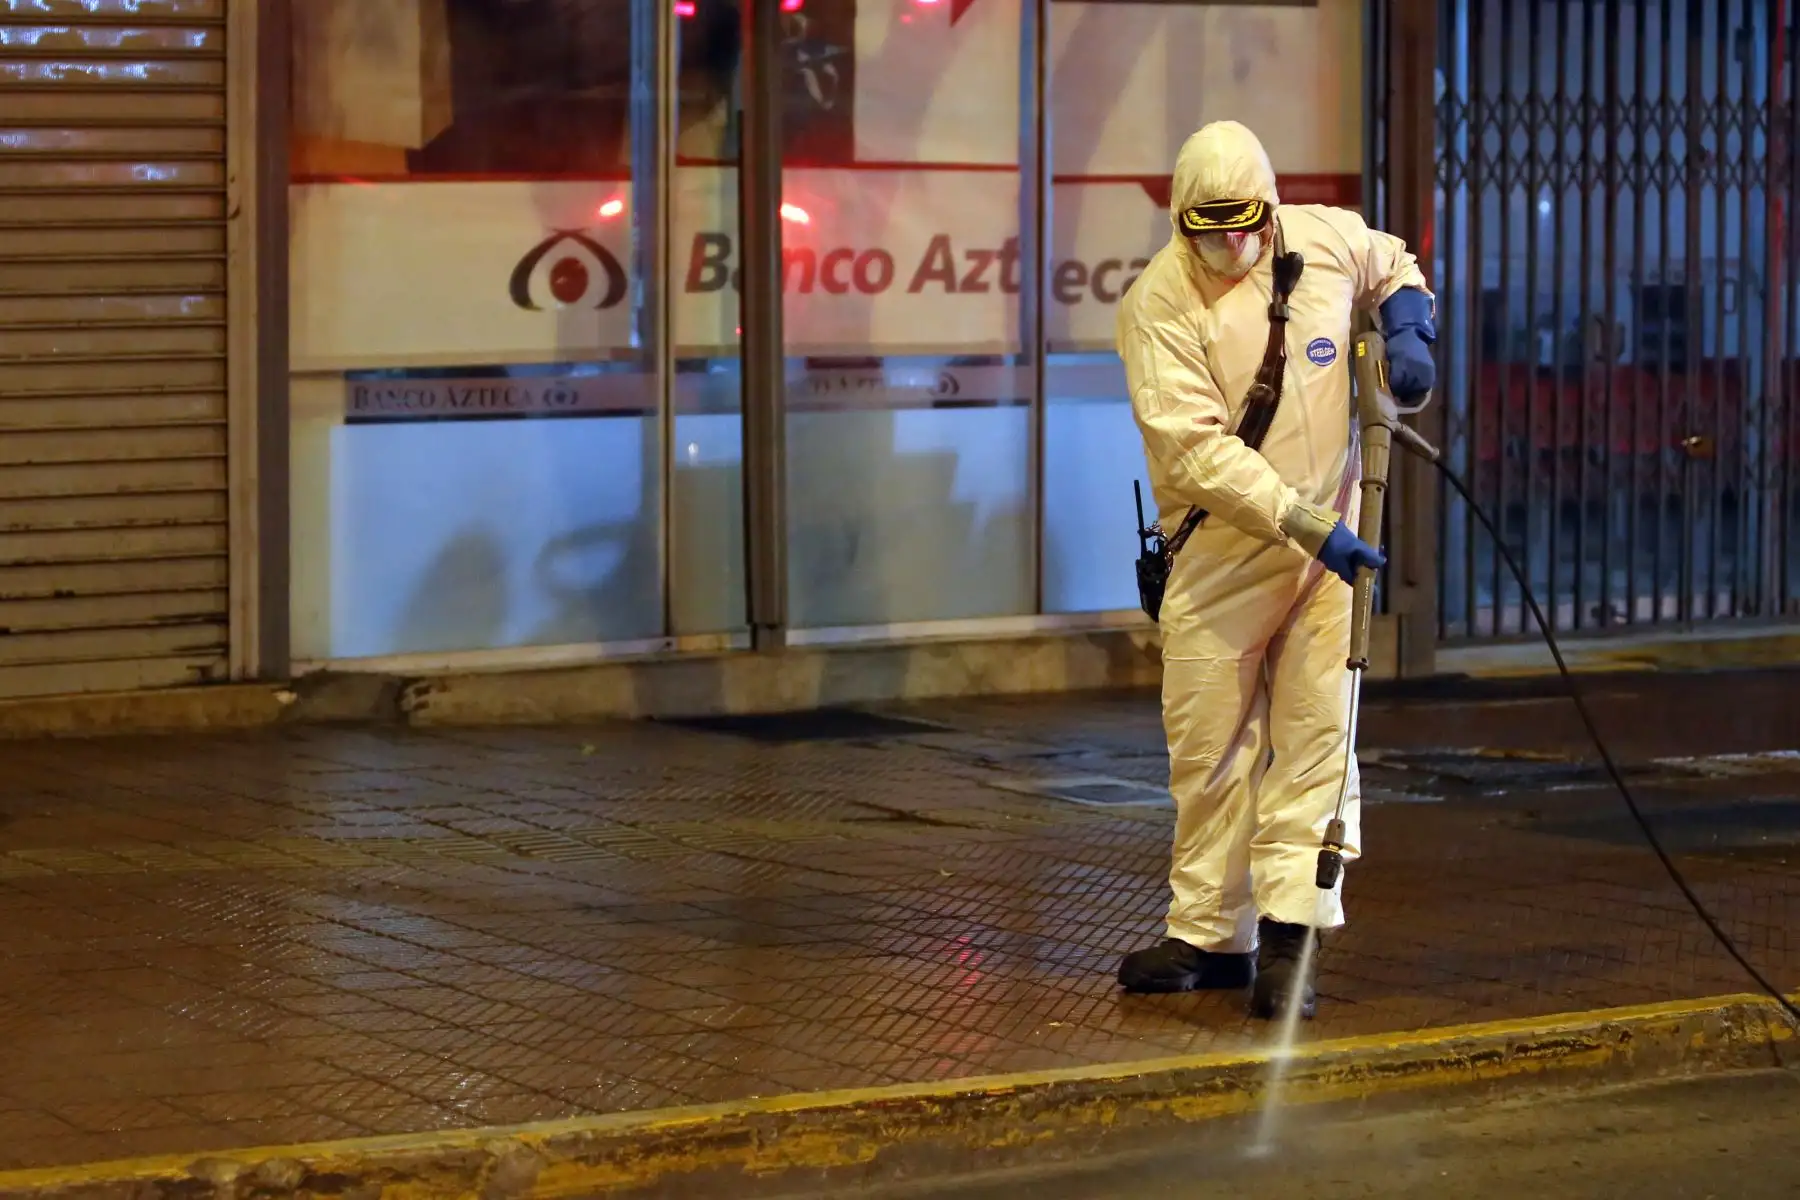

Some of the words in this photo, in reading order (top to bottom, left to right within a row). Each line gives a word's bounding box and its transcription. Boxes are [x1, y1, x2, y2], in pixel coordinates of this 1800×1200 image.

[685, 231, 894, 295] Bnco
[354, 385, 436, 411] BANCO
[441, 384, 534, 409] AZTECA
